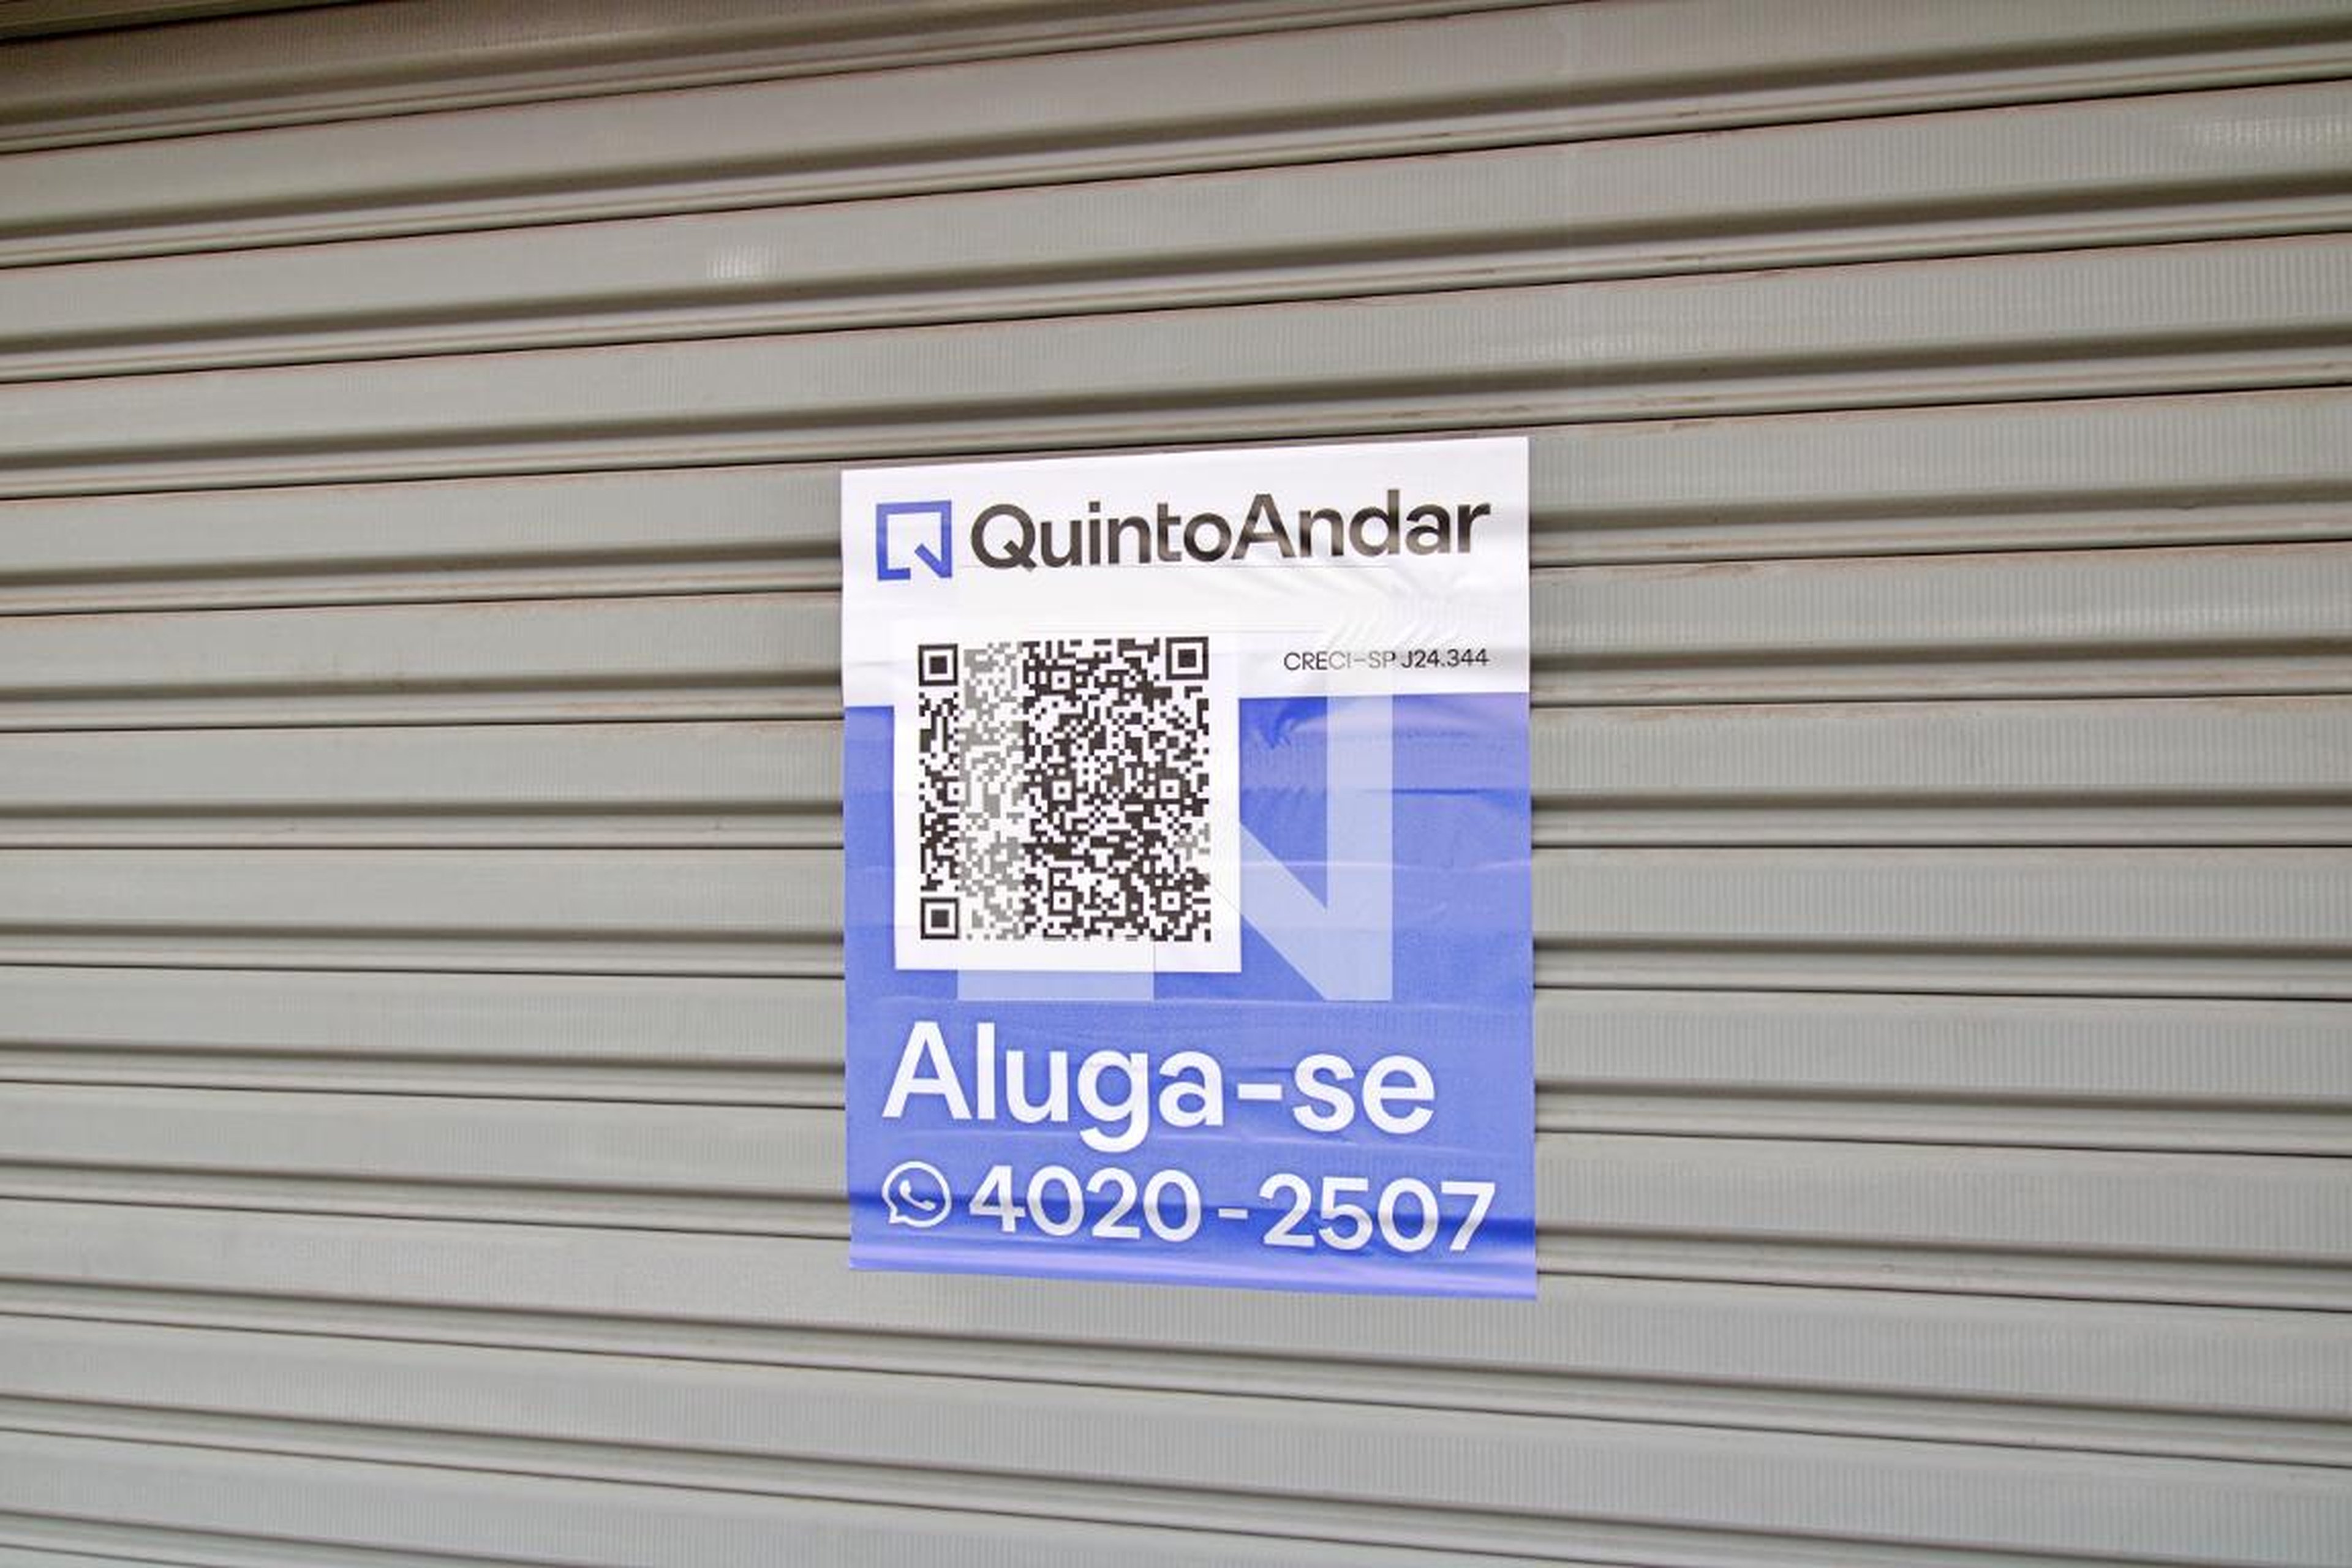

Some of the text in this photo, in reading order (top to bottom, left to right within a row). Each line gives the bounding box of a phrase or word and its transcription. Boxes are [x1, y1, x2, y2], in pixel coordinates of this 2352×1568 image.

[970, 489, 1491, 573] QuintoAndar
[1401, 647, 1490, 669] J24.344
[882, 1020, 1436, 1154] Aluga-se
